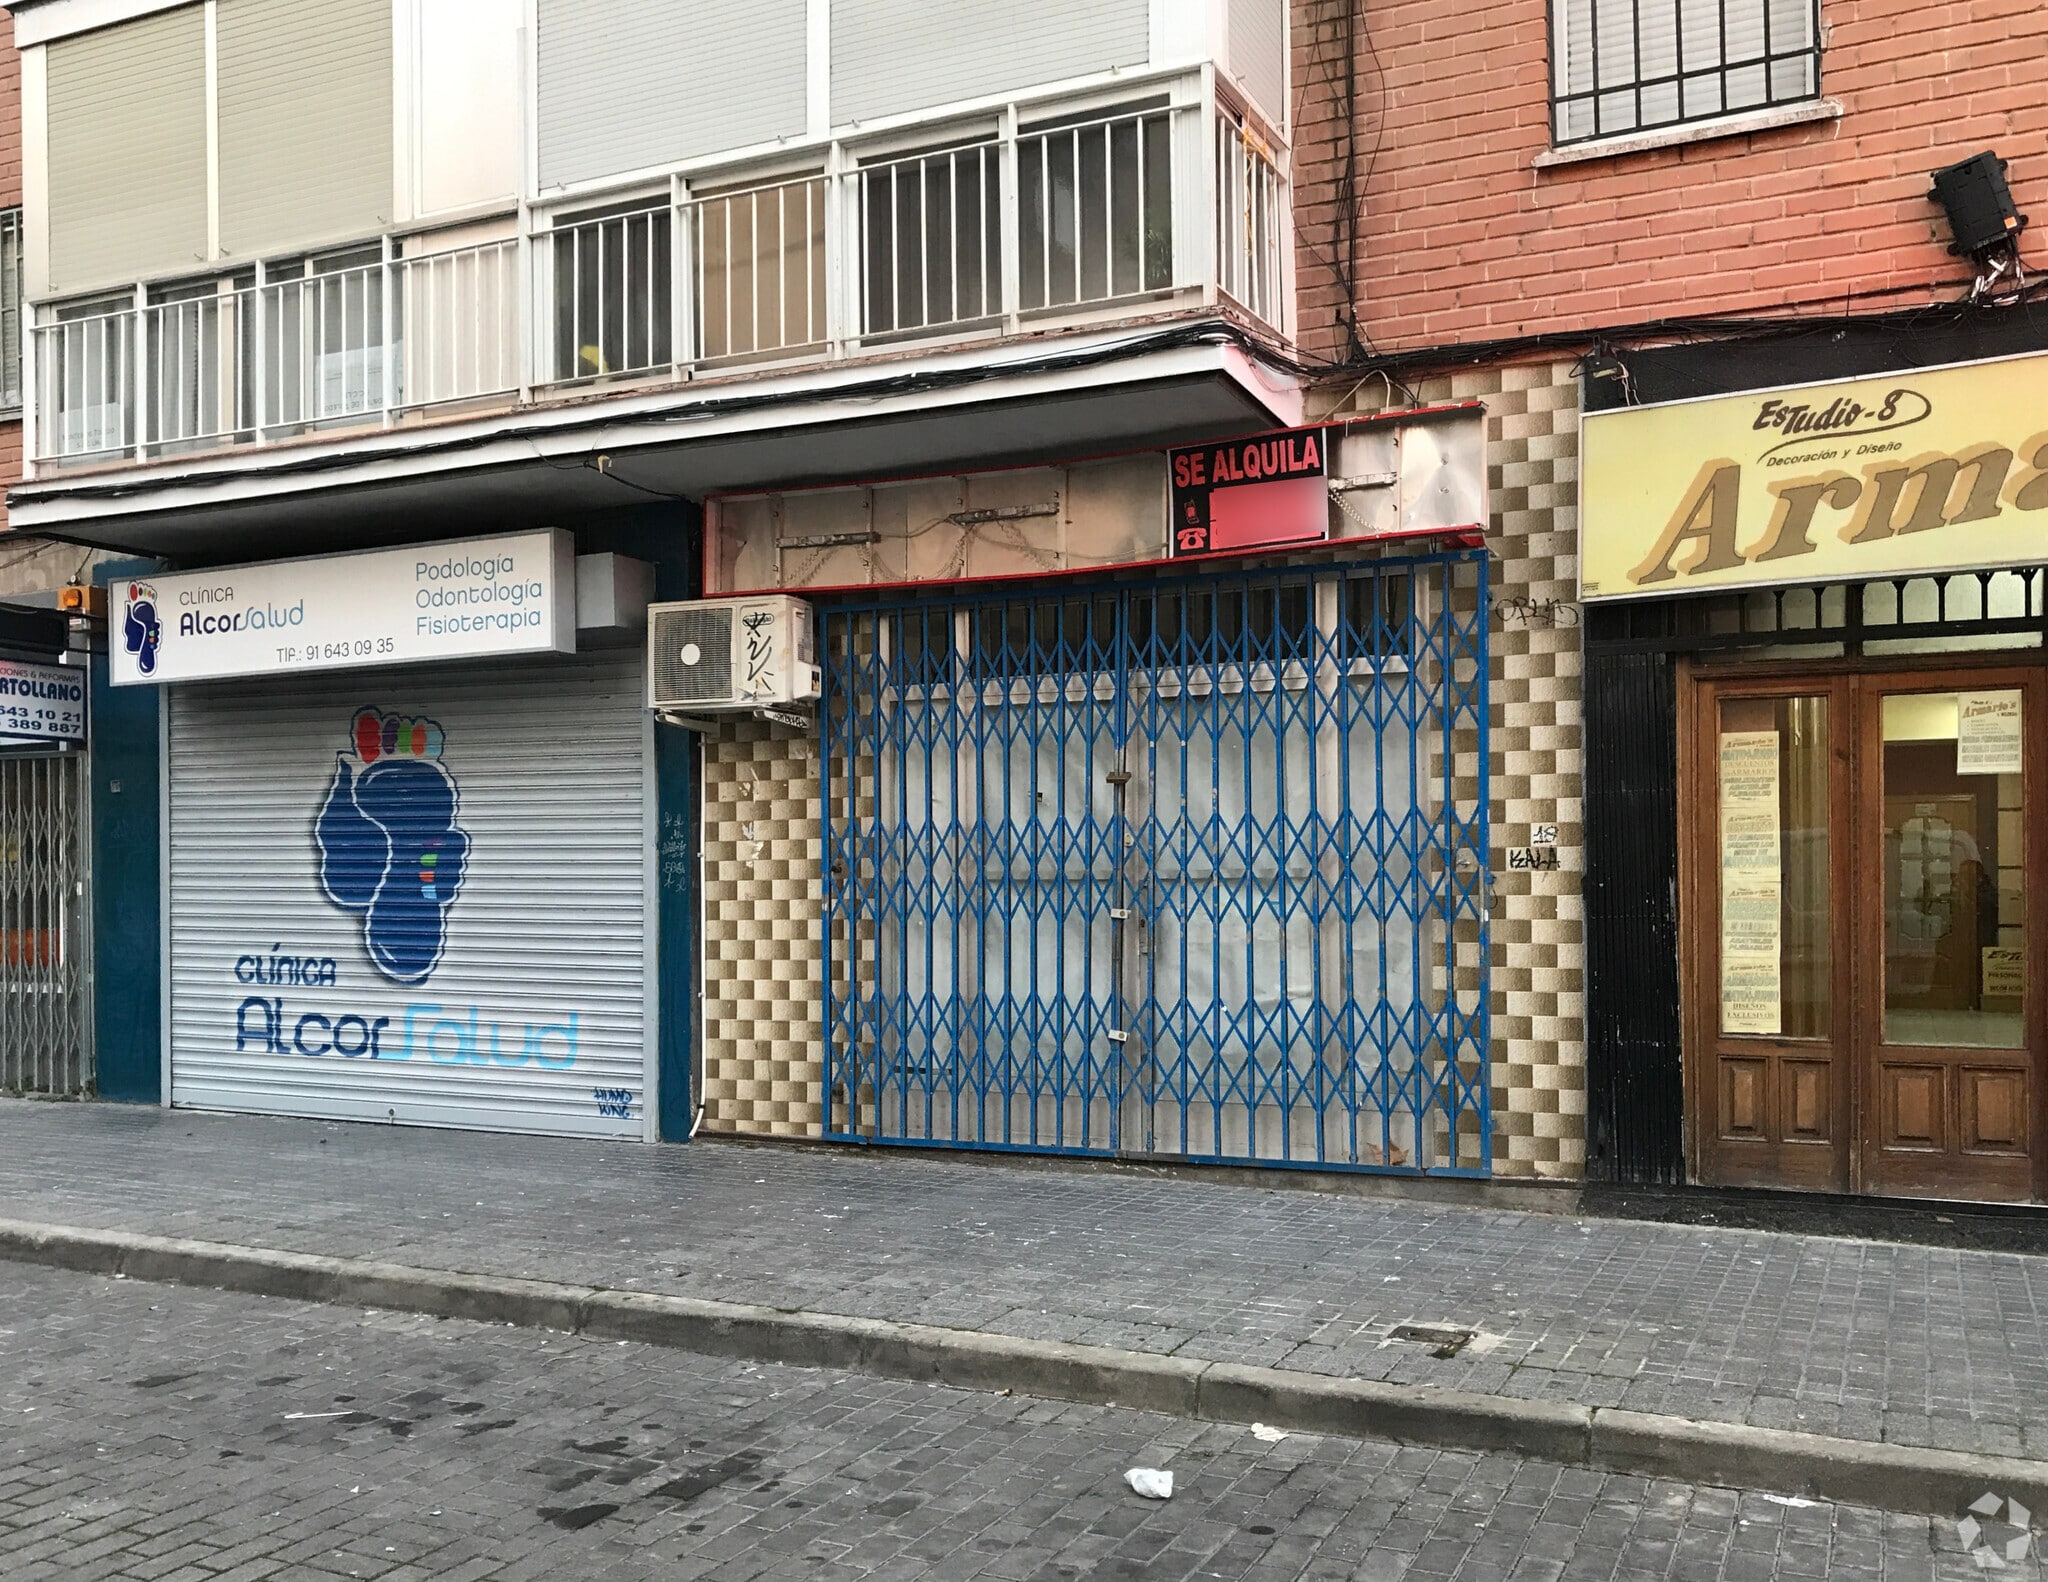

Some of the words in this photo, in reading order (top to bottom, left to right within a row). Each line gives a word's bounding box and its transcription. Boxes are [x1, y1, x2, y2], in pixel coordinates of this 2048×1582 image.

[1174, 451, 1206, 488] SE
[1213, 435, 1321, 483] ALQUILA
[1766, 449, 1837, 467] Decoración
[1842, 450, 1851, 458] y
[1856, 442, 1903, 455] Diseño
[416, 553, 513, 581] Podología
[179, 586, 234, 606] CLÍNICA
[416, 578, 542, 608] Odontología
[417, 607, 541, 636] Fisioterapia
[306, 645, 319, 660] 91
[324, 642, 350, 658] 643
[354, 639, 372, 655] 09
[376, 637, 394, 653] 35
[8, 719, 42, 730] 389
[48, 722, 80, 733] 887
[35, 709, 56, 720] 10
[62, 712, 80, 722] 21
[234, 942, 337, 987] CLÍNICA
